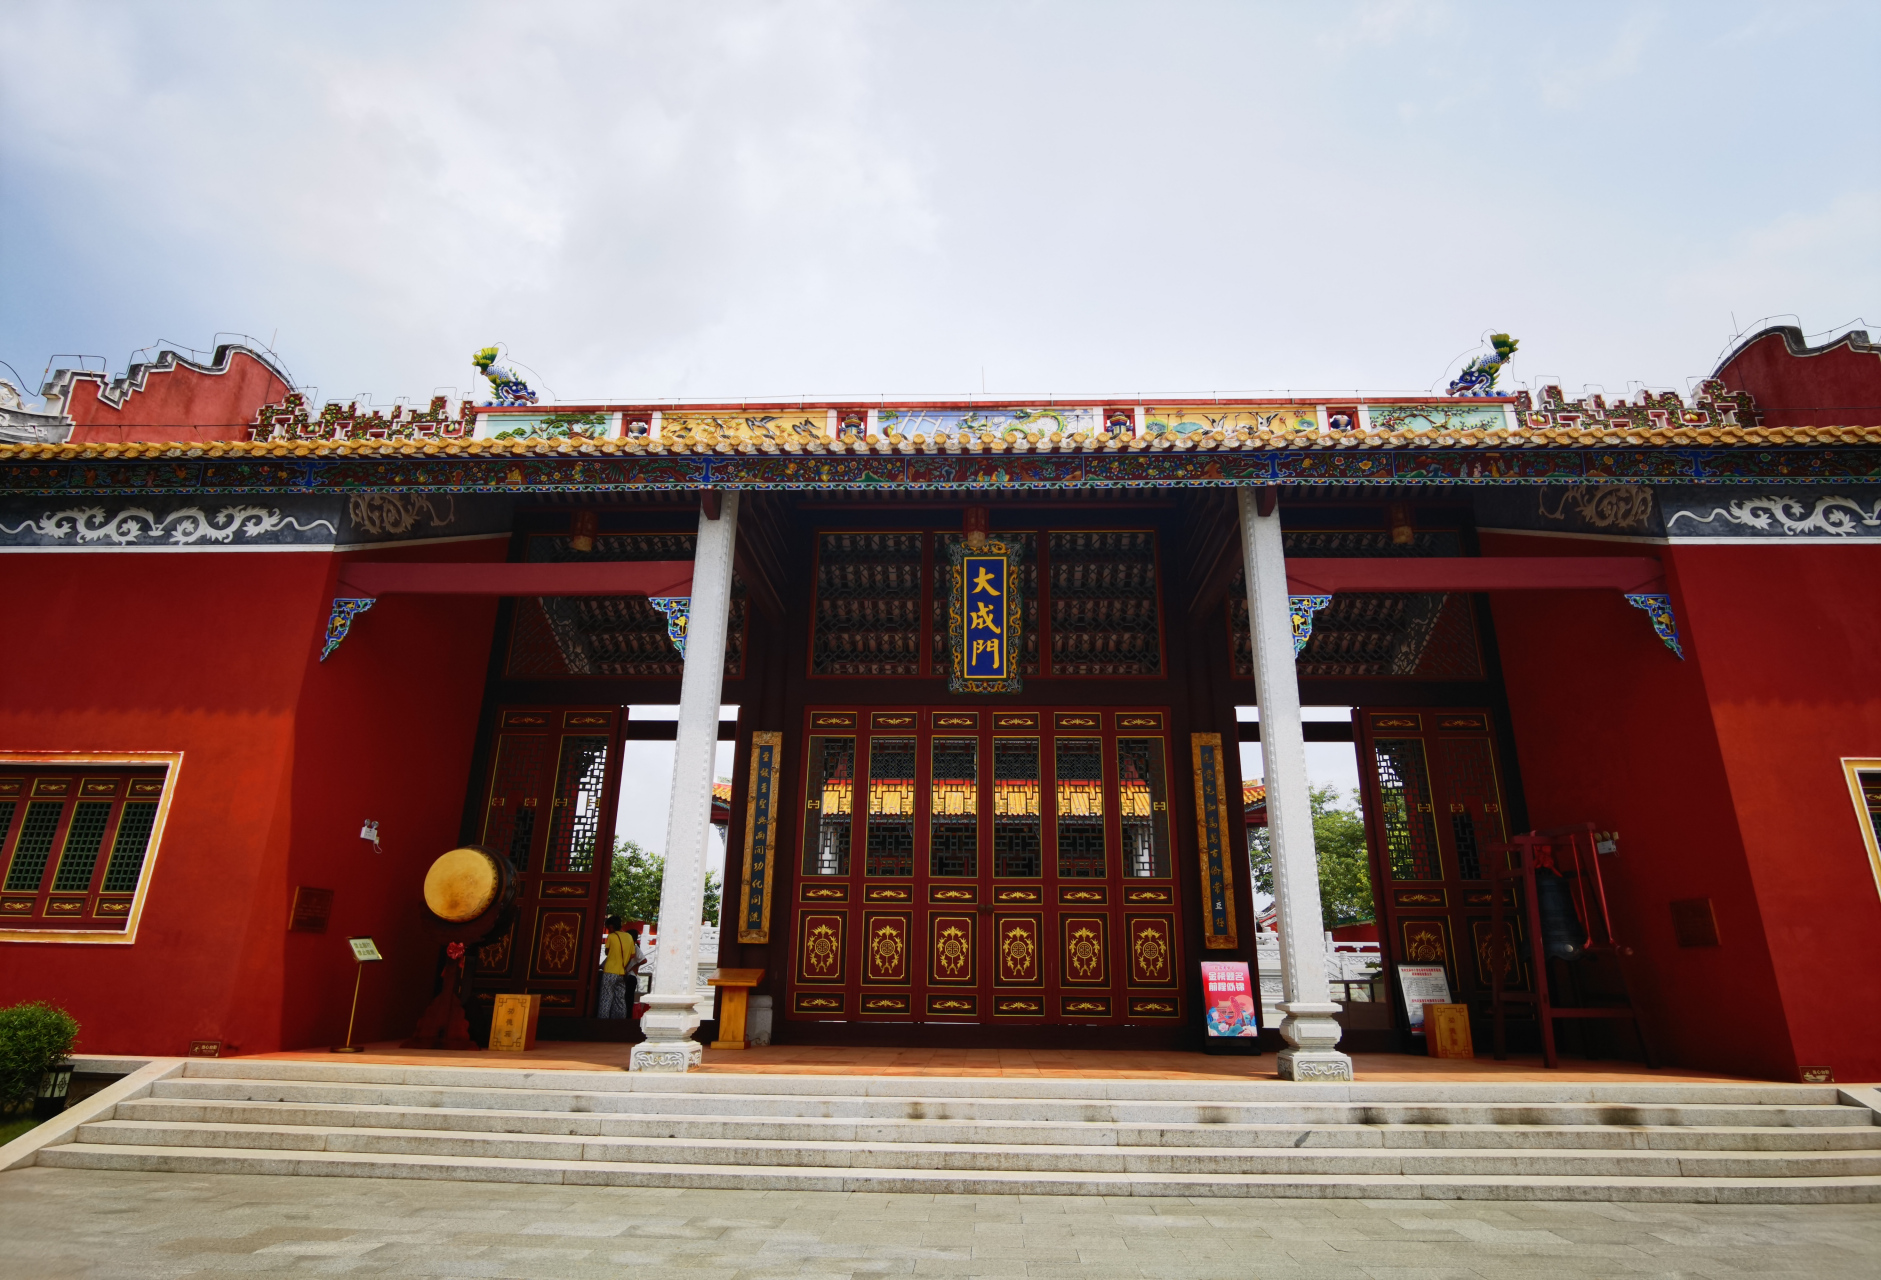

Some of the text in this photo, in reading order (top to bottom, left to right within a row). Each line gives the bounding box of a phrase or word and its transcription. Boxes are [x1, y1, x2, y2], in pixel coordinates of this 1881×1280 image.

[969, 566, 1002, 669] 大成門
[1208, 971, 1244, 981] 金榜题名
[1208, 982, 1245, 992] 前程似锦
